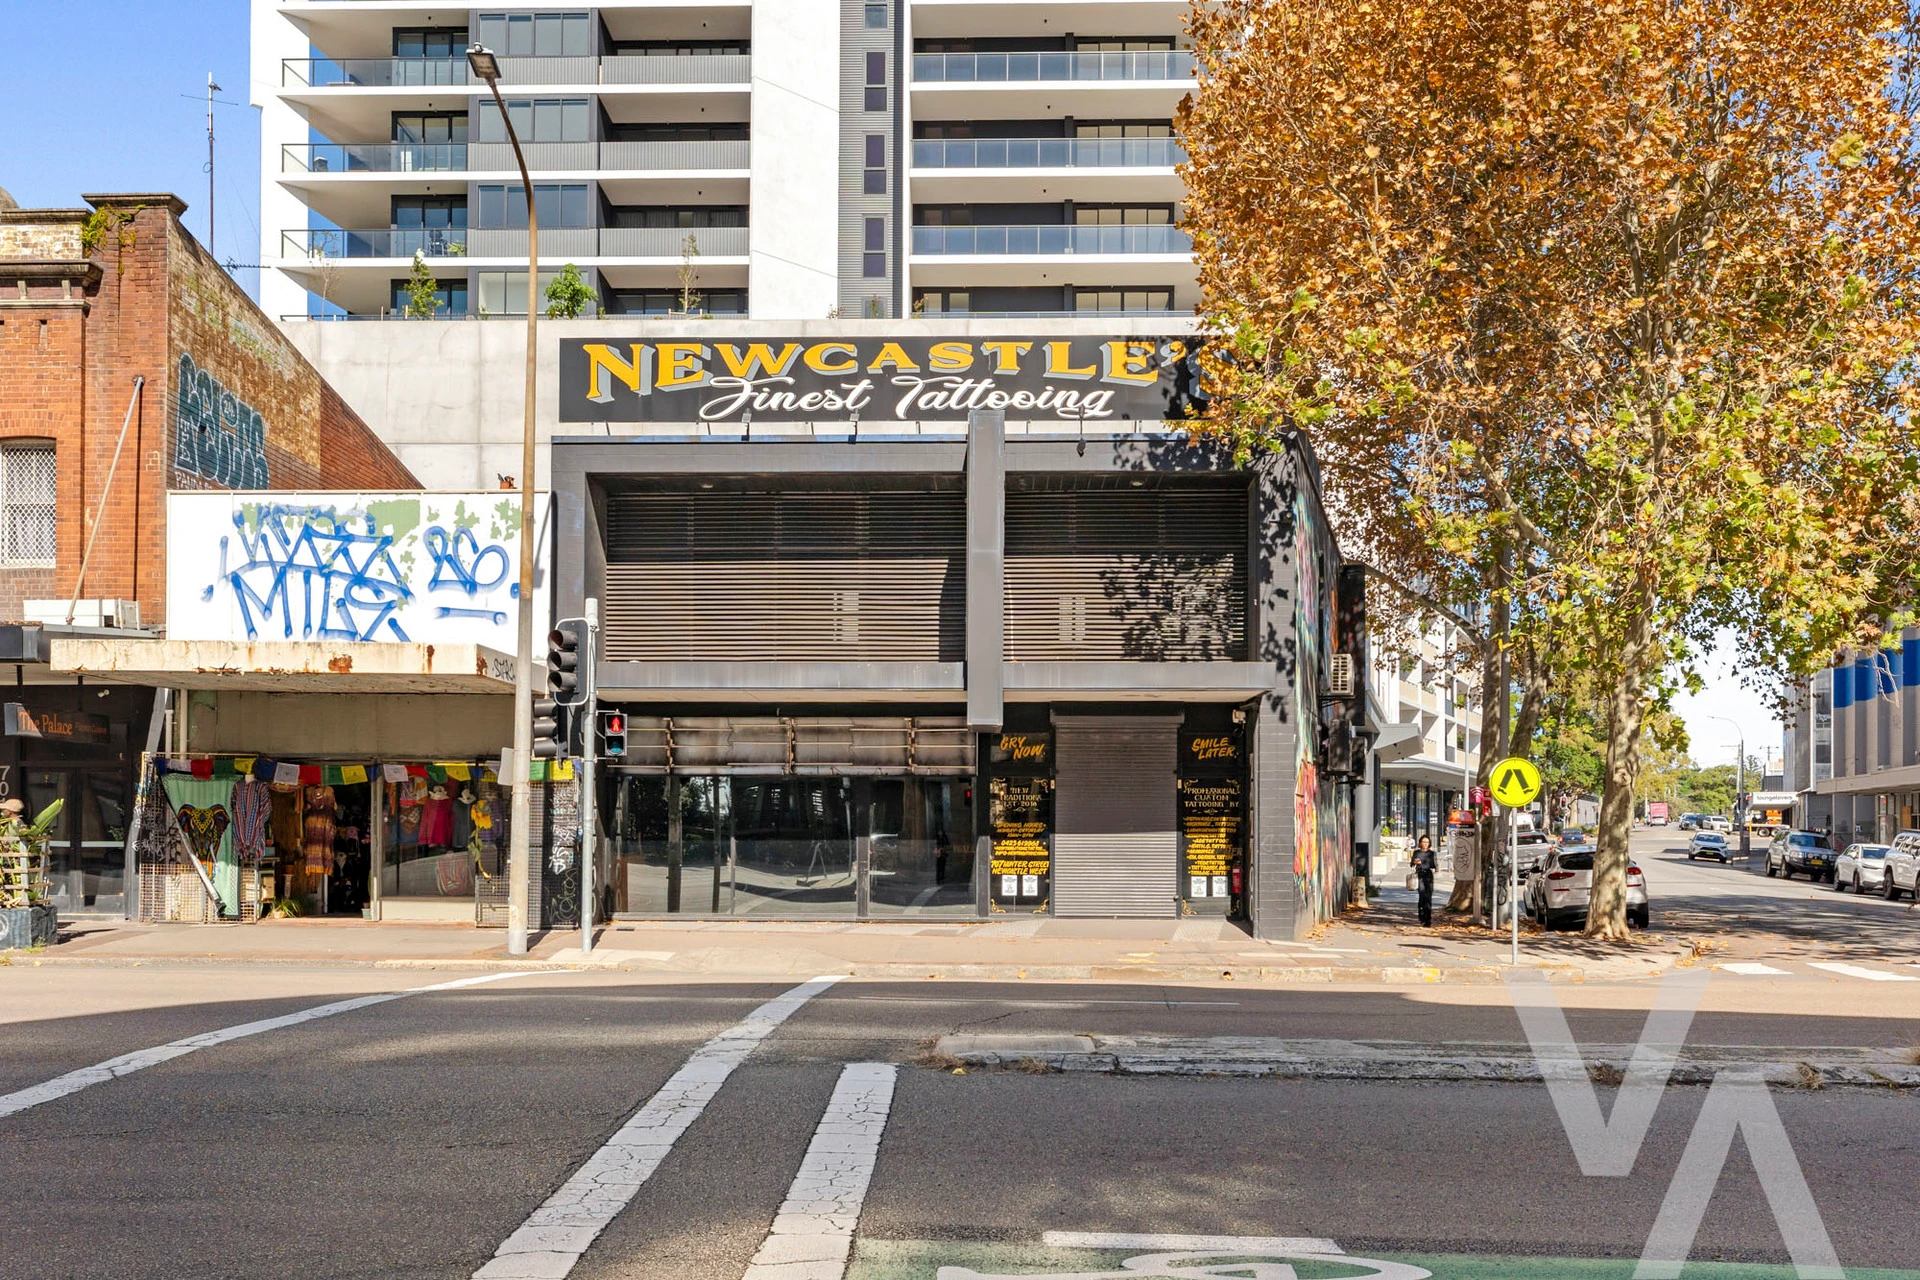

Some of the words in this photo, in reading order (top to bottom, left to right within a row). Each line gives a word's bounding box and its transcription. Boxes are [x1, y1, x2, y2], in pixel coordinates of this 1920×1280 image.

[699, 376, 875, 420] Finest
[891, 375, 1115, 420] Tattooing
[20, 711, 40, 733] The
[41, 713, 73, 735] Palace
[1000, 735, 1027, 751] CRY
[1191, 736, 1230, 752] SMILE
[1013, 743, 1046, 760] NOW
[1197, 746, 1236, 760] LATER
[1756, 793, 1793, 802] loungelovers
